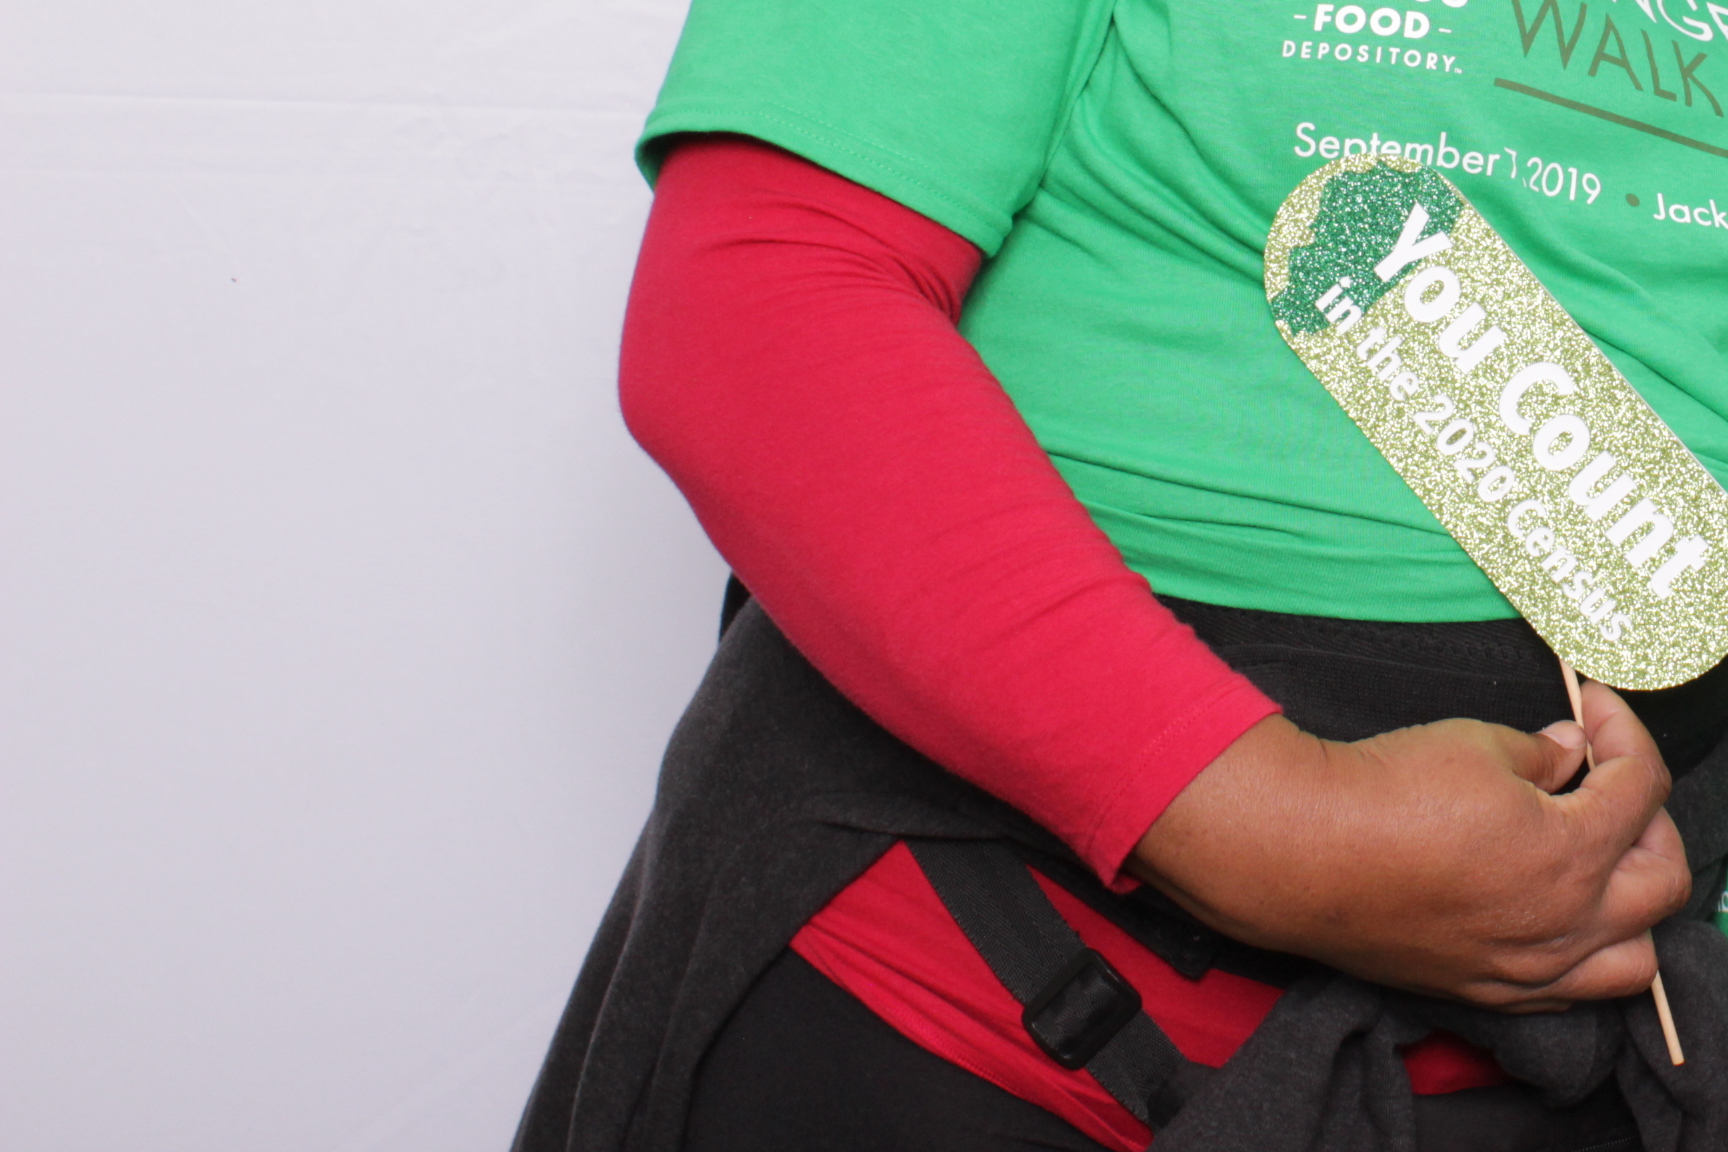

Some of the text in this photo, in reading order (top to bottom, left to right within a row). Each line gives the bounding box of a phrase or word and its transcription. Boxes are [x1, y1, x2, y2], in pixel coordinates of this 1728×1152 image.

[1526, 156, 1602, 205] 2019
[1314, 275, 1633, 641] in the 2020 Census
[1373, 203, 1709, 599] You Count
